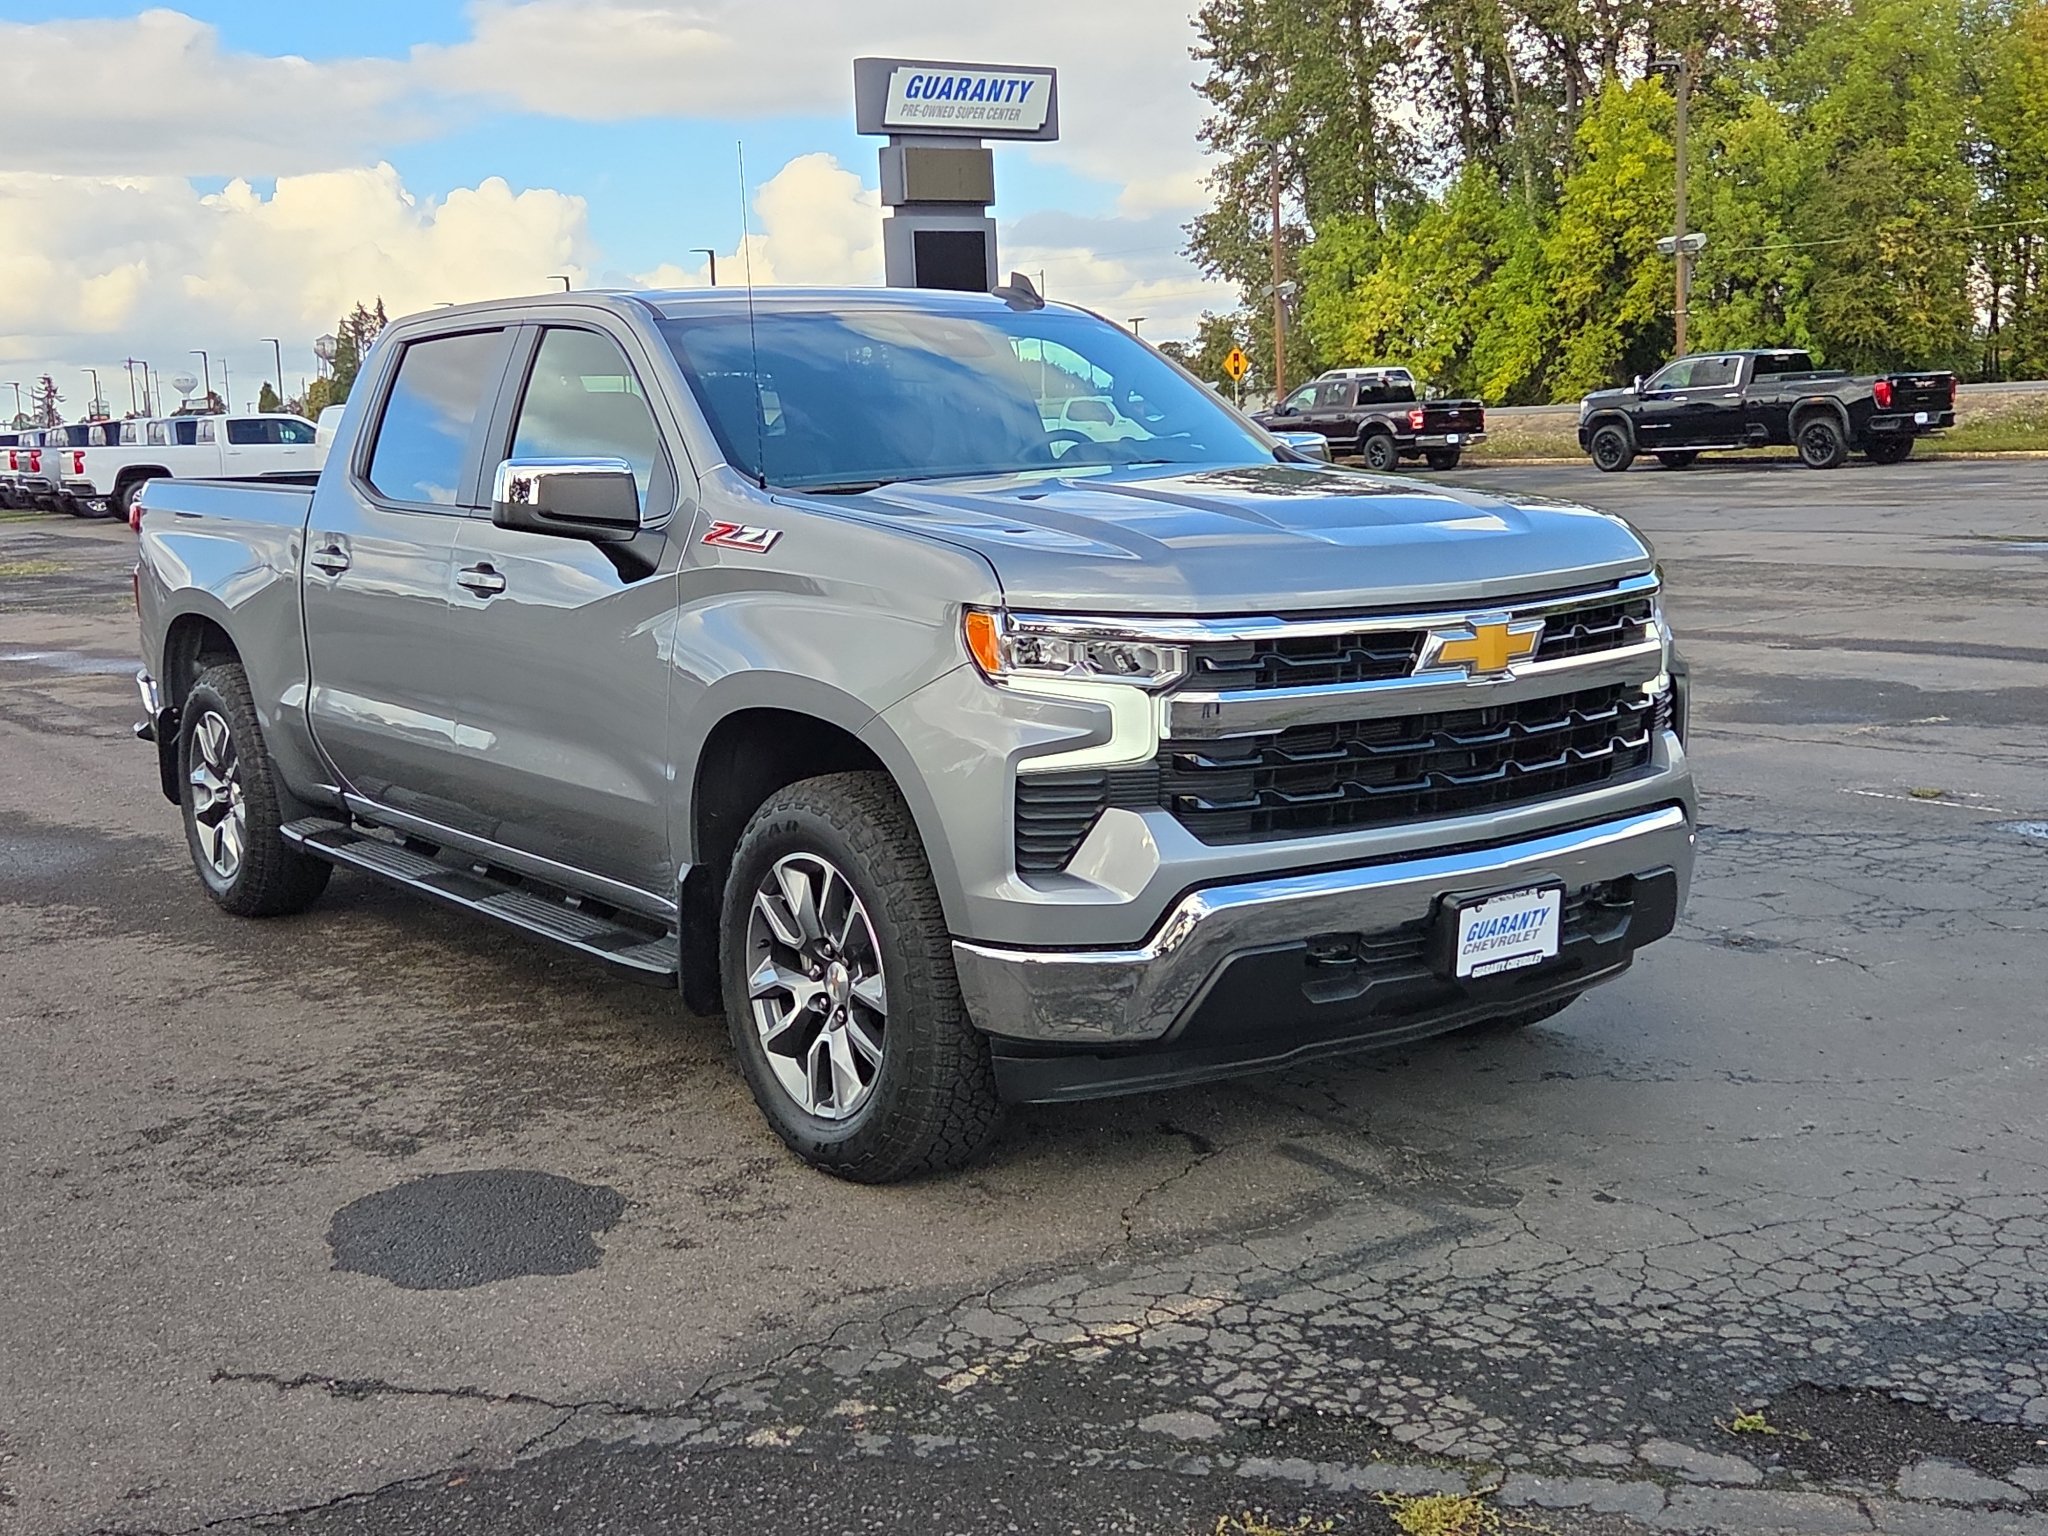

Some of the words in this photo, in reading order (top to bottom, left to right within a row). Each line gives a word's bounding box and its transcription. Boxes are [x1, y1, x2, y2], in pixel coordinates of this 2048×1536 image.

[905, 75, 1034, 103] GUARANTY
[900, 103, 955, 118] PRE-OWNED
[955, 105, 985, 119] SUPER
[986, 107, 1022, 120] CENTER
[701, 520, 784, 553] Z71
[1466, 907, 1550, 942] GUARANTY
[1462, 928, 1540, 955] CHEVROLET
